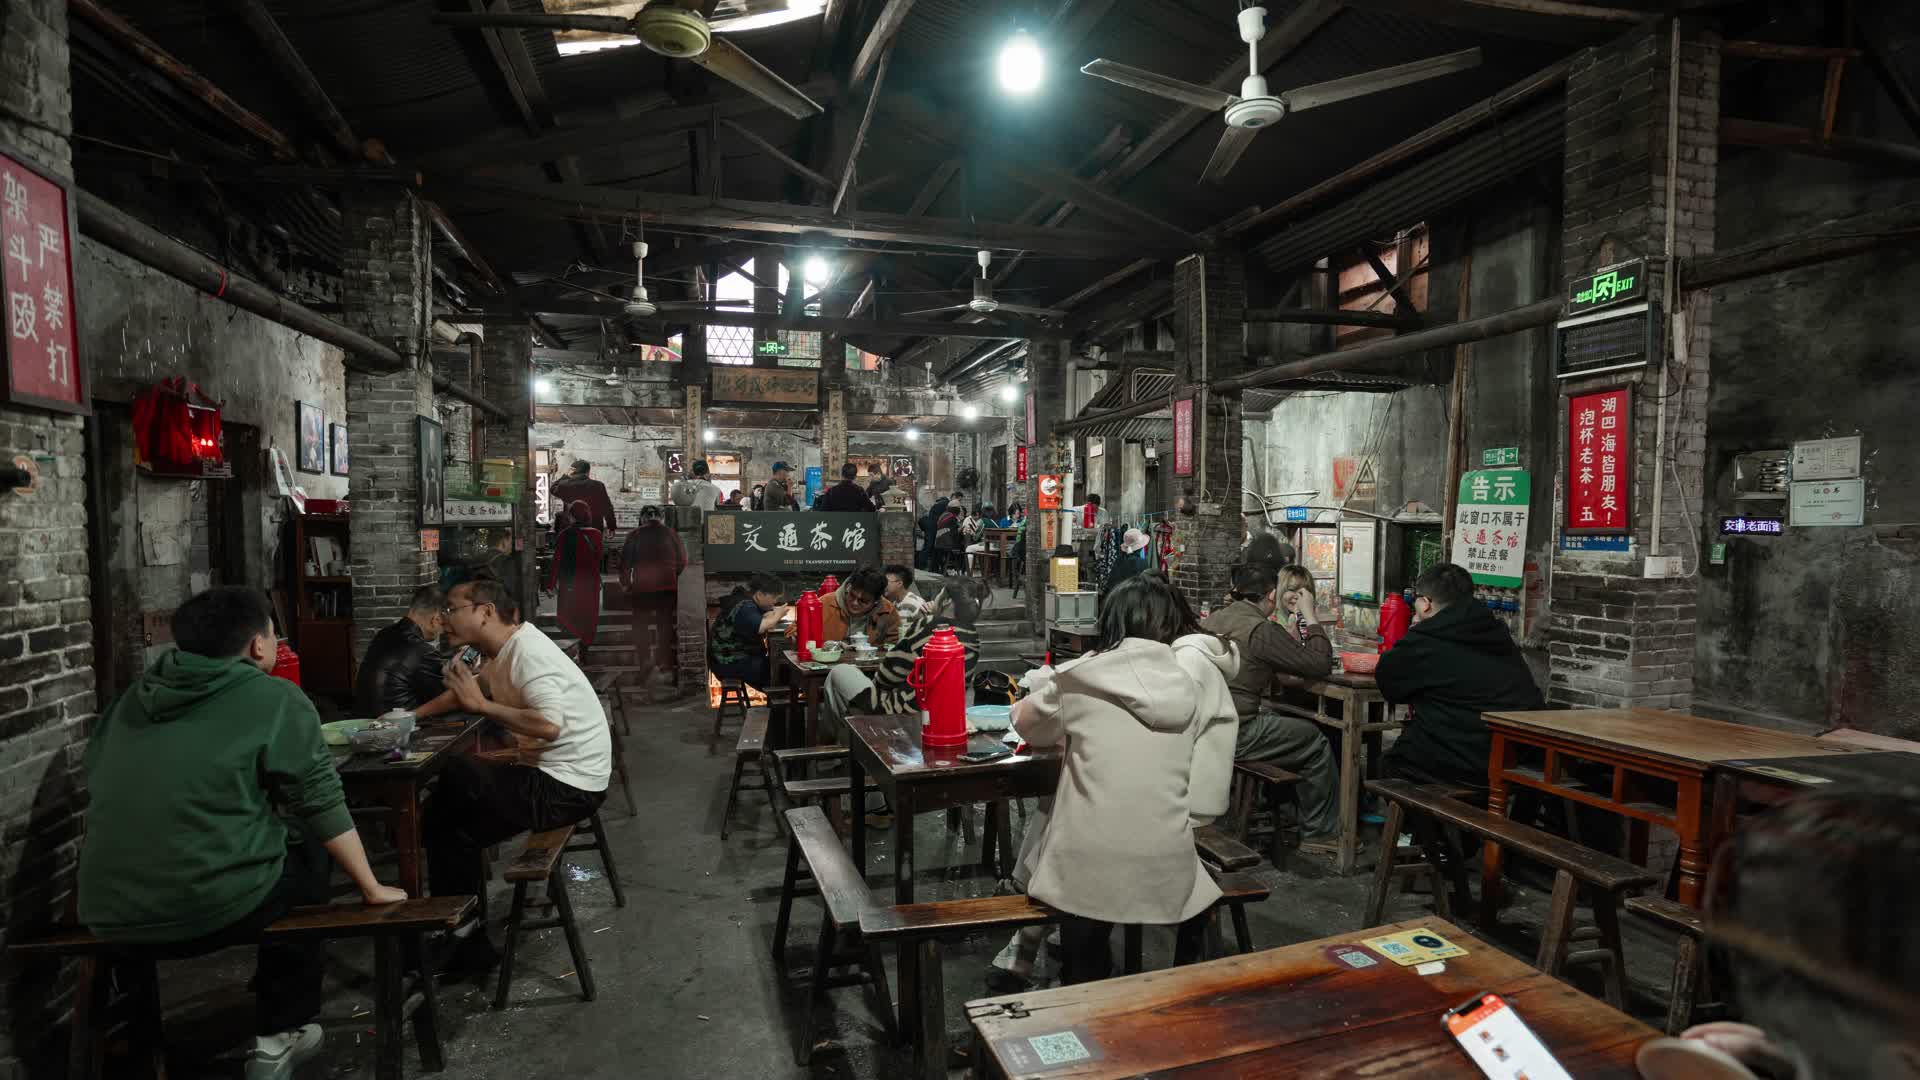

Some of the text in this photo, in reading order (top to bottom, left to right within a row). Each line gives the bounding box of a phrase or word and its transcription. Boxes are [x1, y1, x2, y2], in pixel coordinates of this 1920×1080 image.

[3, 170, 39, 344] 架斗殴
[1616, 276, 1635, 292] EXIT
[38, 222, 69, 386] 严禁打
[1579, 408, 1595, 522] 泡杯老茶，五
[1601, 397, 1617, 525] 湖四海皆朋友！
[1471, 475, 1517, 501] 告示
[1460, 511, 1525, 527] 此窗口不属于
[741, 520, 866, 552] 交通茶馆
[1462, 528, 1519, 549] 交通茶馆
[1467, 547, 1509, 561] 禁止点餐
